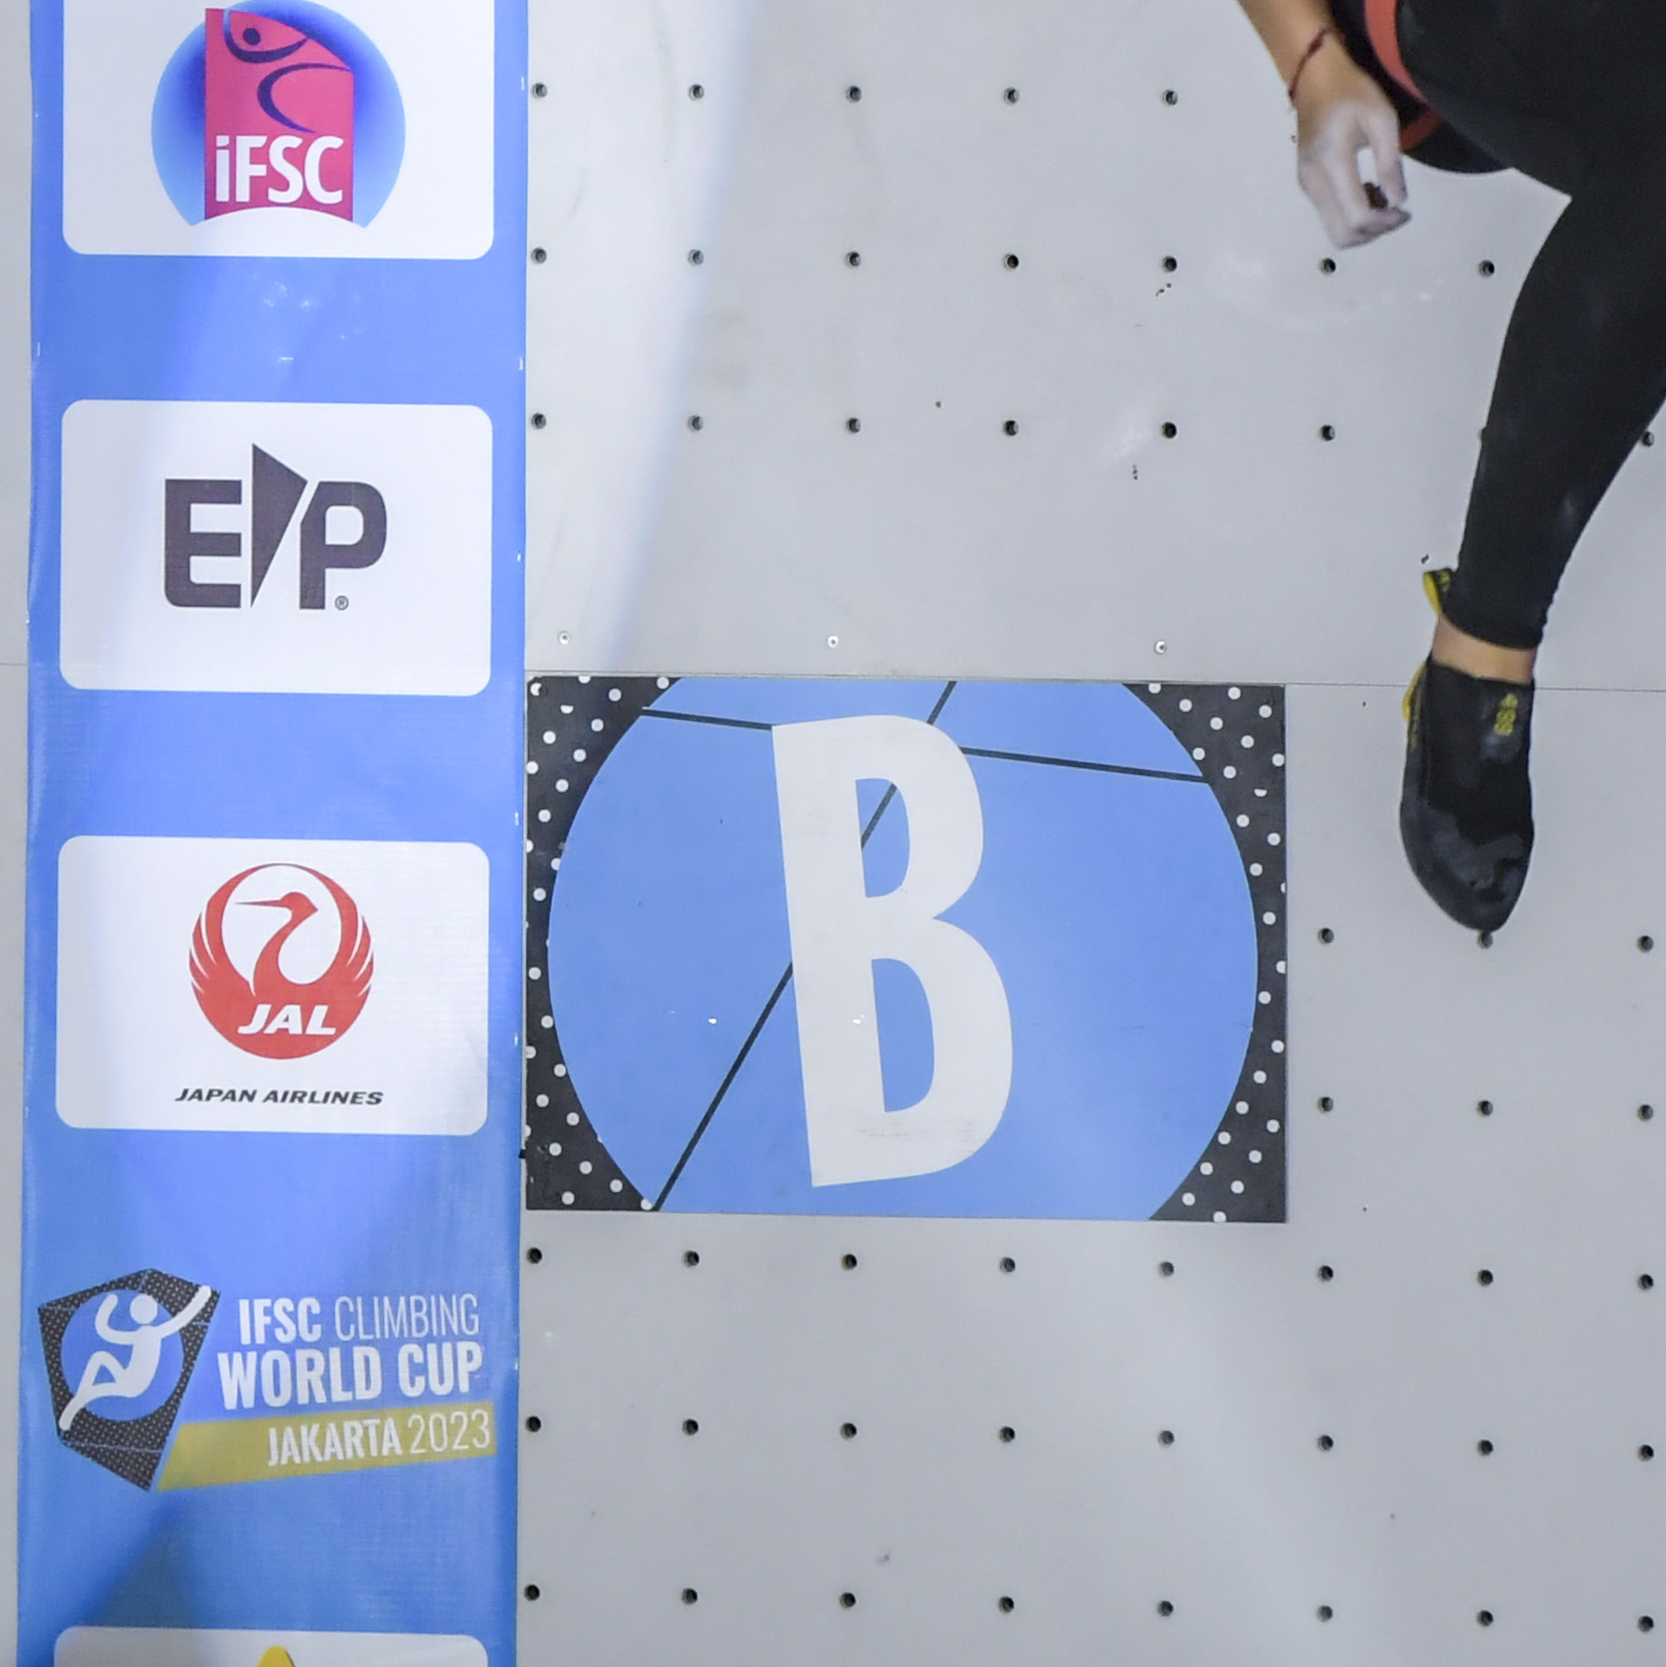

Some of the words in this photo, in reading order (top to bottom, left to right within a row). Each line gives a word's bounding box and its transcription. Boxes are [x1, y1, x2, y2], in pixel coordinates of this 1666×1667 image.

[772, 714, 1013, 1187] B
[237, 1004, 336, 1035] JAL
[175, 1088, 257, 1103] JAPAN
[262, 1089, 384, 1105] AIRLINES
[239, 1297, 322, 1345] IFSC
[334, 1293, 479, 1341] CLIMBING
[217, 1346, 382, 1410] WORLD
[397, 1341, 484, 1397] CUP
[268, 1418, 402, 1467] JAKARTA
[407, 1409, 491, 1454] 2023
